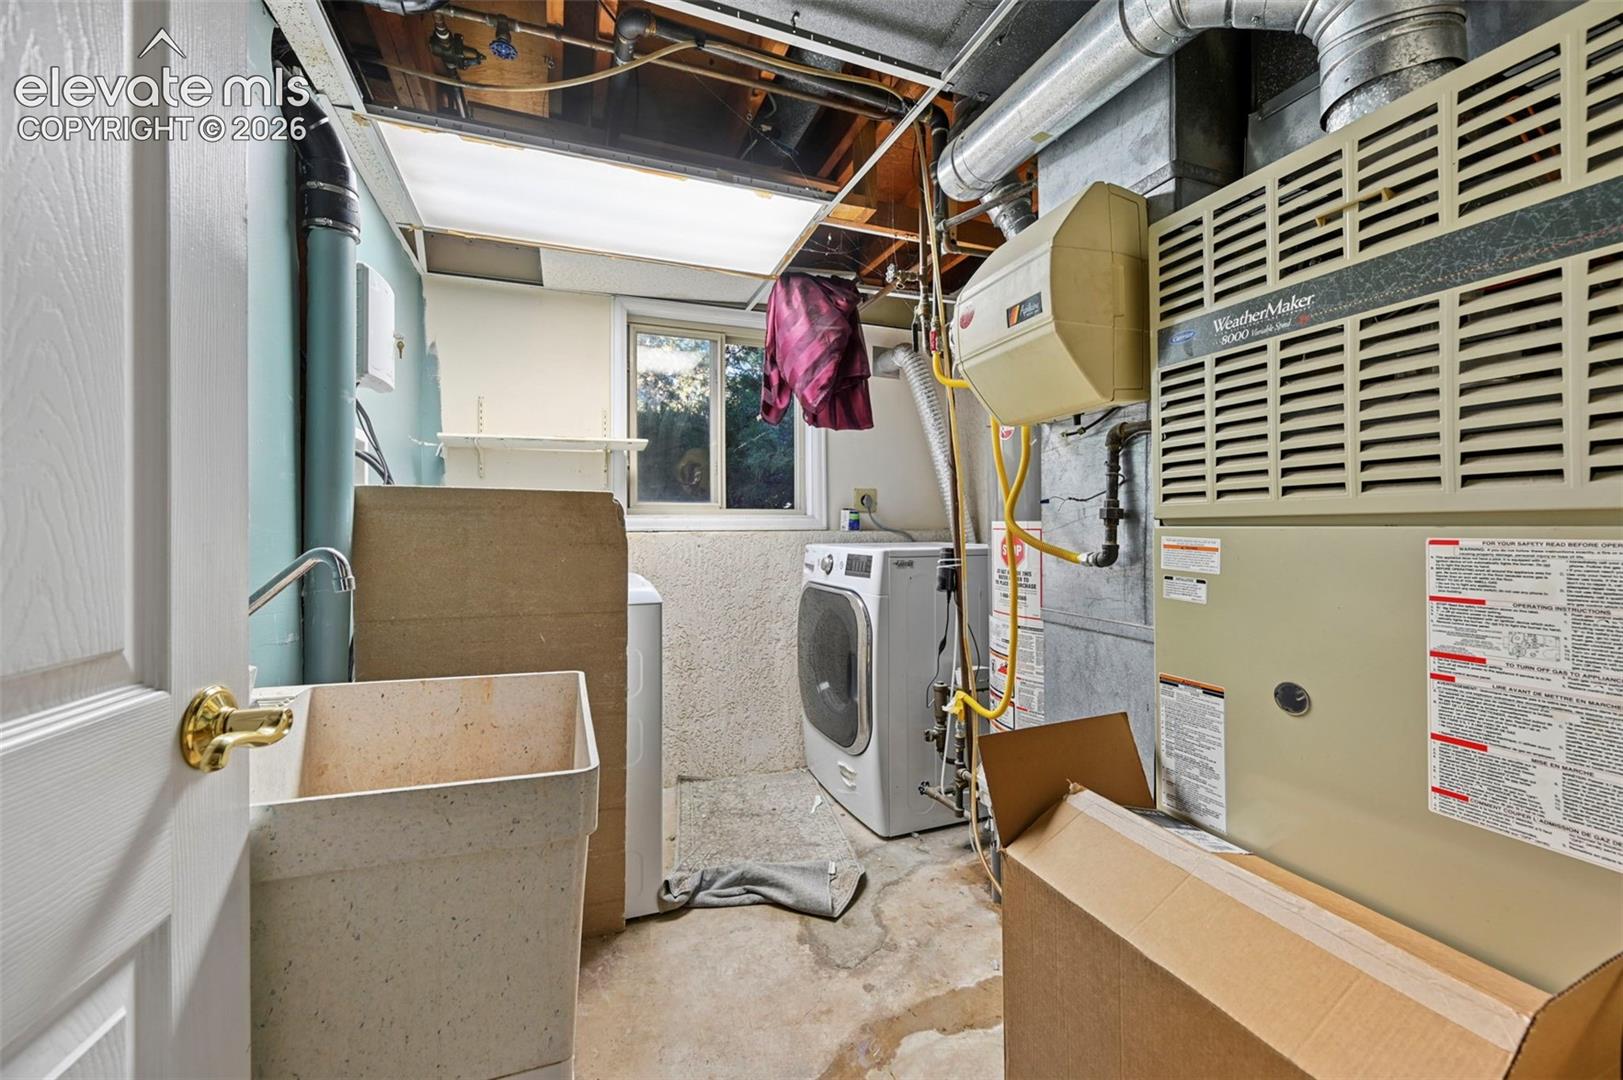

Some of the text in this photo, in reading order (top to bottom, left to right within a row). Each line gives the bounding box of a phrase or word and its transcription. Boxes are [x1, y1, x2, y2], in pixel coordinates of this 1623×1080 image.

[1221, 328, 1250, 346] 8000
[1002, 544, 1022, 556] SP
[1555, 606, 1612, 615] INSTRUCTIONS
[1544, 693, 1573, 702] METTRE
[1562, 766, 1594, 777] MARCHE
[1470, 798, 1502, 810] COMMENT
[1503, 808, 1531, 821] COUPER
